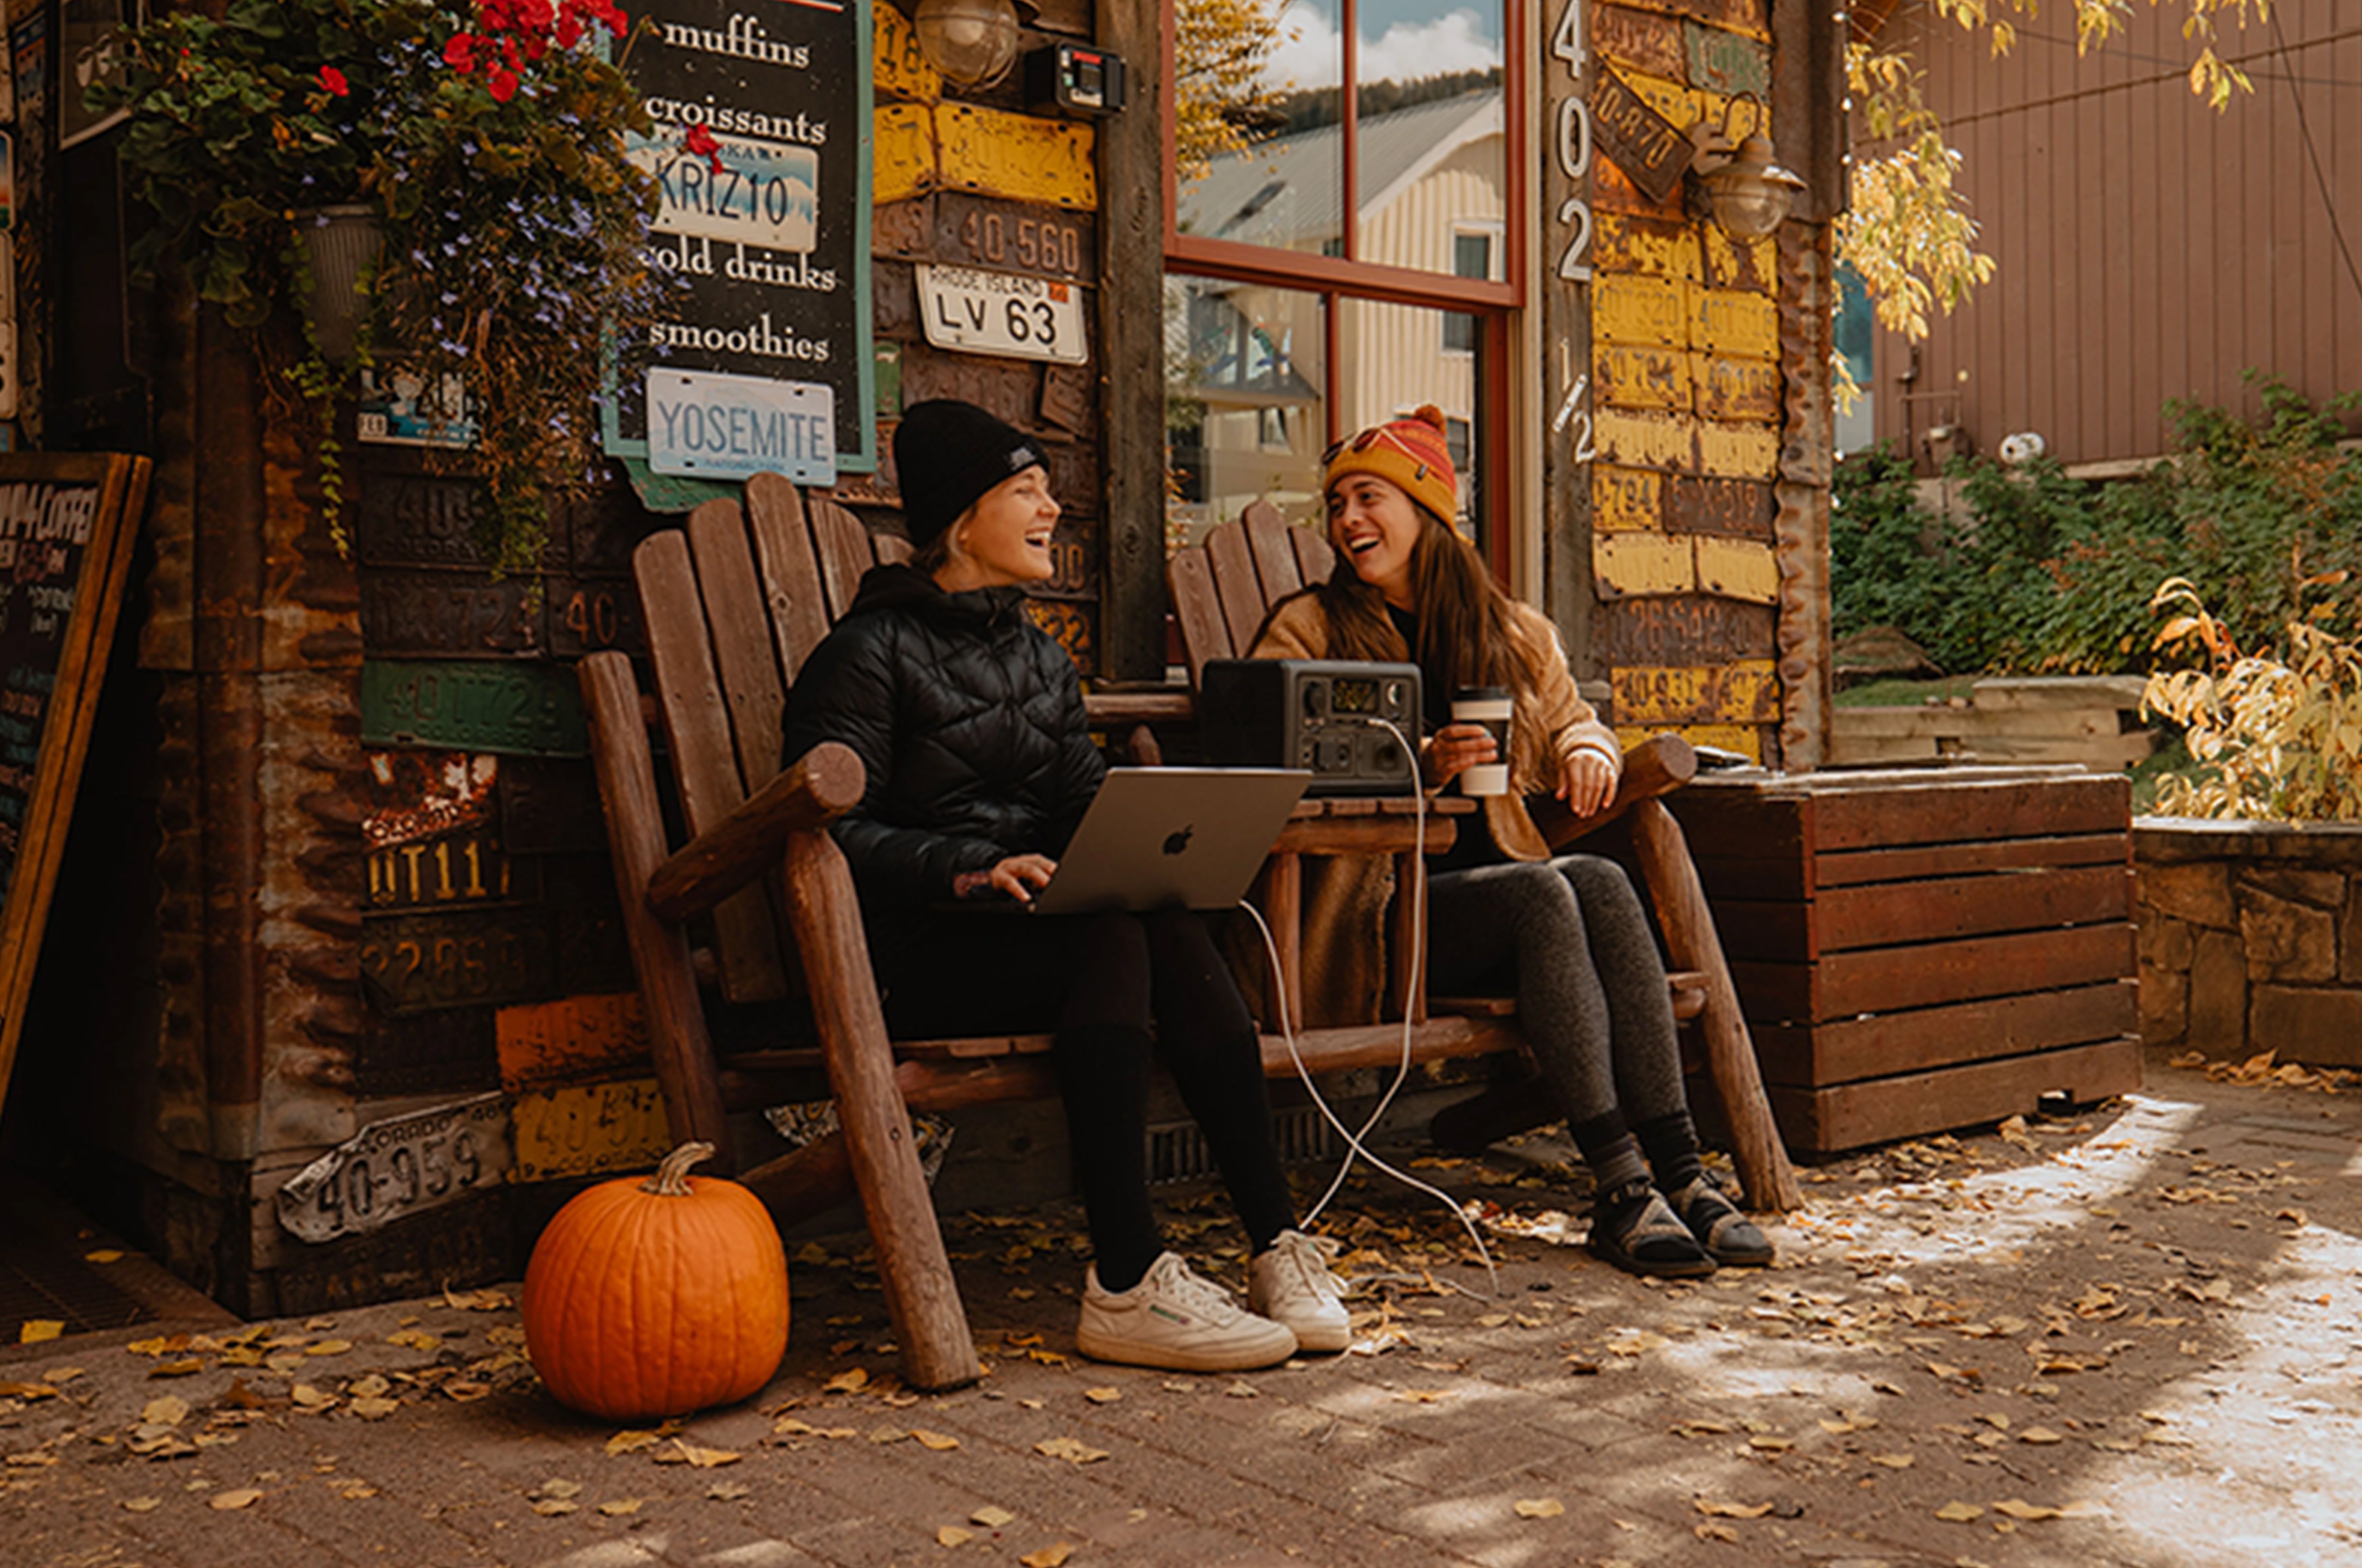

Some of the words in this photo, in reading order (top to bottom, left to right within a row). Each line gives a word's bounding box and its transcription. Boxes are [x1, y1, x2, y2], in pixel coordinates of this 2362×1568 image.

[663, 13, 810, 69] muffins
[646, 95, 827, 145] croissants
[725, 242, 836, 292] drinks
[650, 314, 829, 360] smoothies
[936, 293, 986, 331] LV
[1006, 298, 1056, 345] 63
[658, 400, 828, 461] YOSEMITE
